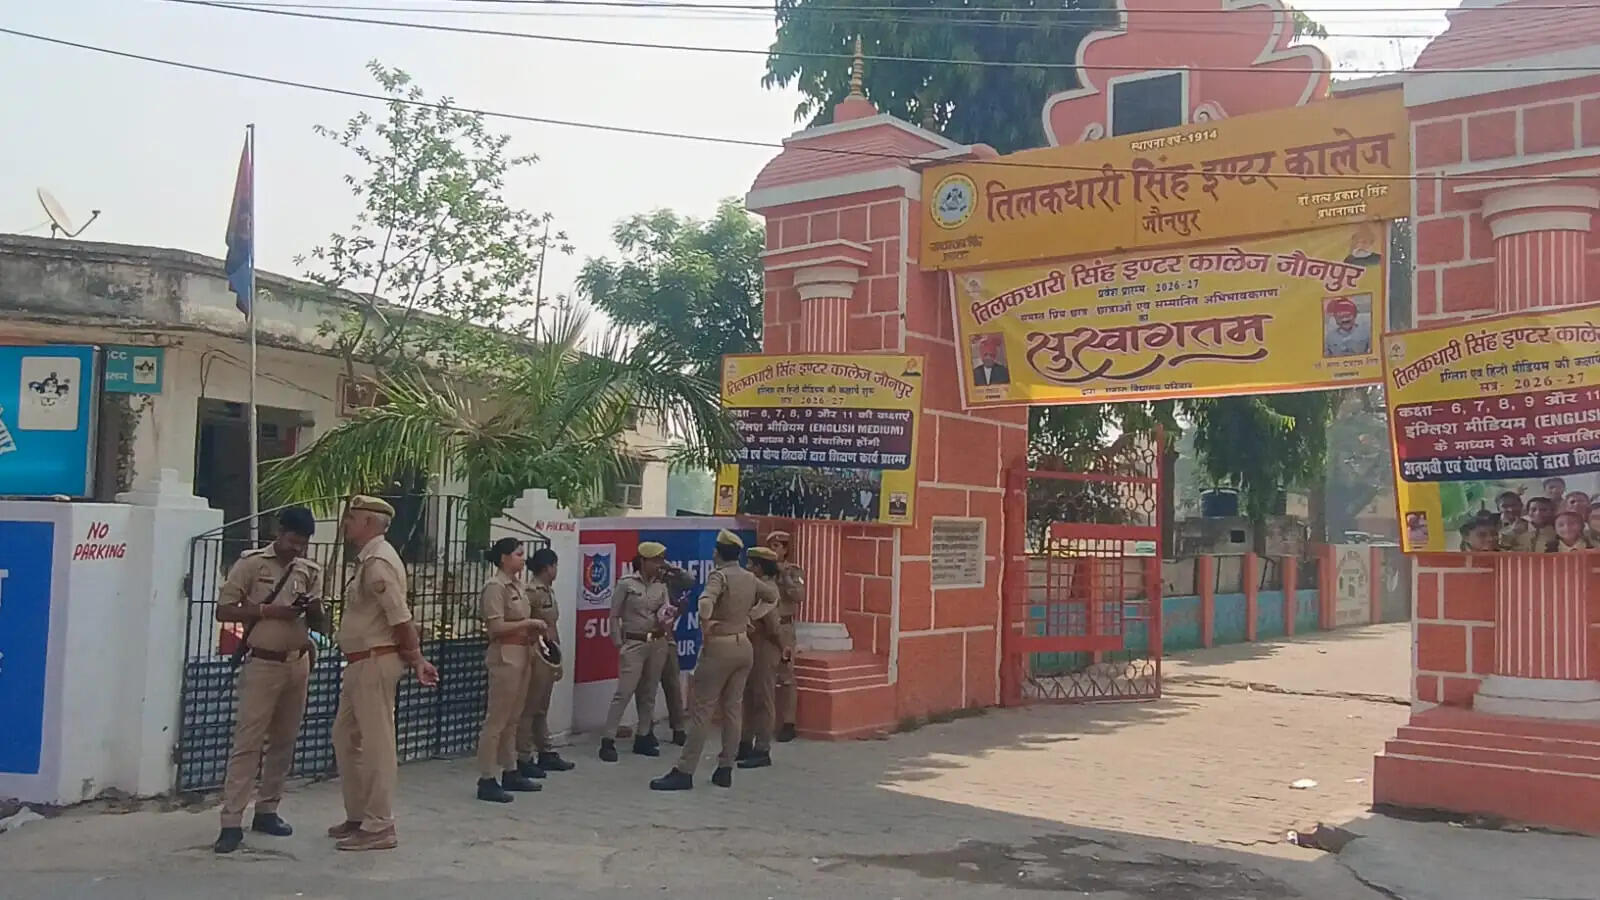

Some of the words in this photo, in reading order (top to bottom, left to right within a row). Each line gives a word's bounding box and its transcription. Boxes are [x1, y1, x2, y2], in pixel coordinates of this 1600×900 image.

[986, 163, 1125, 222] तिलकधारी
[1132, 155, 1195, 202] सिंह
[1200, 151, 1279, 202] इण्टर
[1284, 128, 1395, 180] कालेज
[1334, 189, 1365, 202] प्रकाश
[1366, 184, 1388, 197] सिंह
[1142, 206, 1200, 236] जौनपुर
[970, 270, 1066, 325] तिलकधारी
[1072, 259, 1117, 287] सिंह
[1122, 254, 1184, 281] इण्टर
[1188, 247, 1272, 273] कालेज
[1276, 250, 1365, 292] जौनपुर
[1155, 279, 1200, 293] 2026-27
[1155, 294, 1199, 308] सम्मानित
[1392, 339, 1462, 390] तिलकधारी
[1464, 329, 1498, 355] सिंह
[1500, 327, 1551, 350] इण्टर
[1553, 320, 1600, 343] काले
[727, 364, 774, 396] तिलकधारी
[776, 360, 797, 377] सिंह
[799, 362, 828, 377] इण्टर
[831, 362, 872, 381] कालेज
[874, 371, 915, 399] जौनपुर
[1524, 395, 1535, 408] 9
[1544, 391, 1578, 405] और
[804, 409, 813, 418] 9
[1404, 421, 1458, 439] इंग्लिश
[1463, 415, 1527, 432] मीडियम
[1433, 438, 1448, 451] के
[1454, 439, 1495, 450] माध्यम
[1500, 435, 1514, 447] से
[1519, 433, 1536, 446] भी
[1444, 455, 1462, 473] एवं
[87, 521, 109, 540] NO
[72, 542, 127, 561] PARKING
